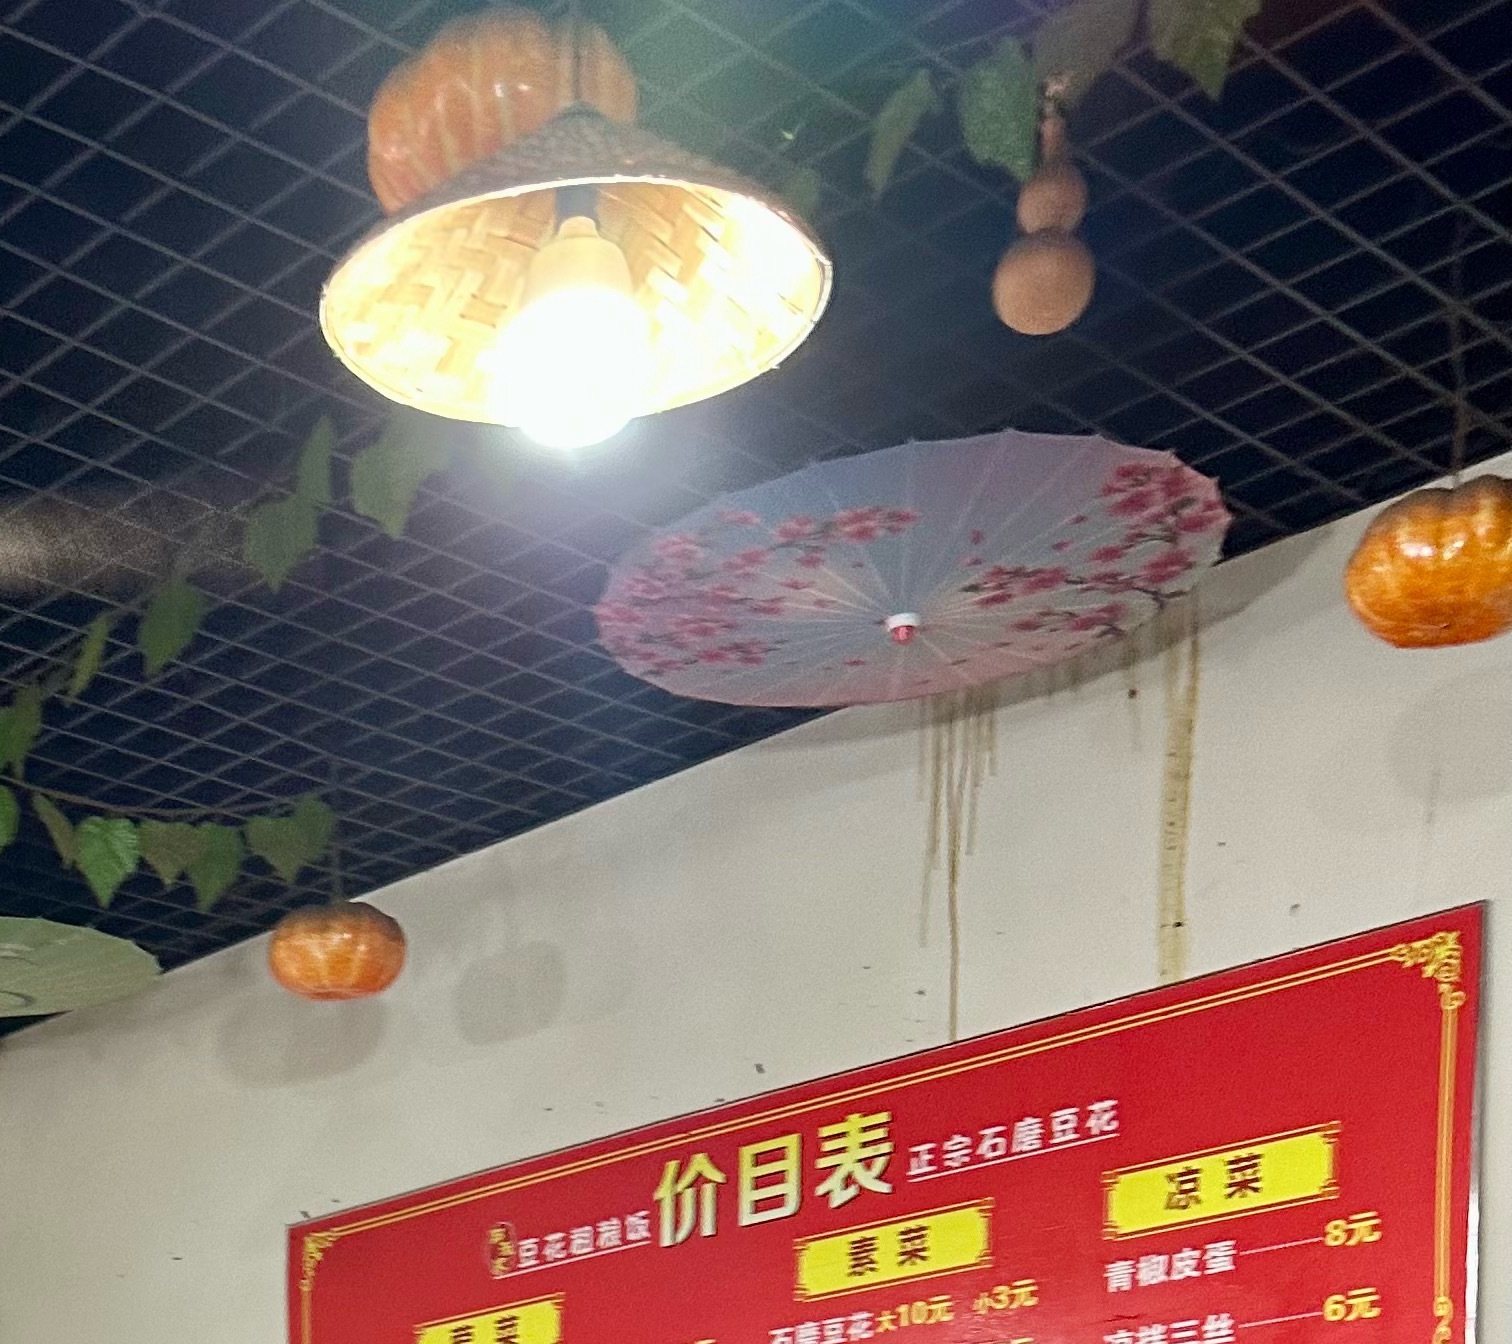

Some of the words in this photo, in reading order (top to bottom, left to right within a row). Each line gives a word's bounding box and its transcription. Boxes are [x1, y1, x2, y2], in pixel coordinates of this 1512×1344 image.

[906, 1098, 1121, 1177] 正宗石磨豆花
[653, 1111, 894, 1248] 价目表
[1164, 1152, 1265, 1212] 凉菜
[847, 1224, 931, 1278] 素菜
[1103, 1240, 1238, 1293] 青椒皮蛋
[1324, 1211, 1383, 1247] 8元
[1323, 1287, 1382, 1321] 6元
